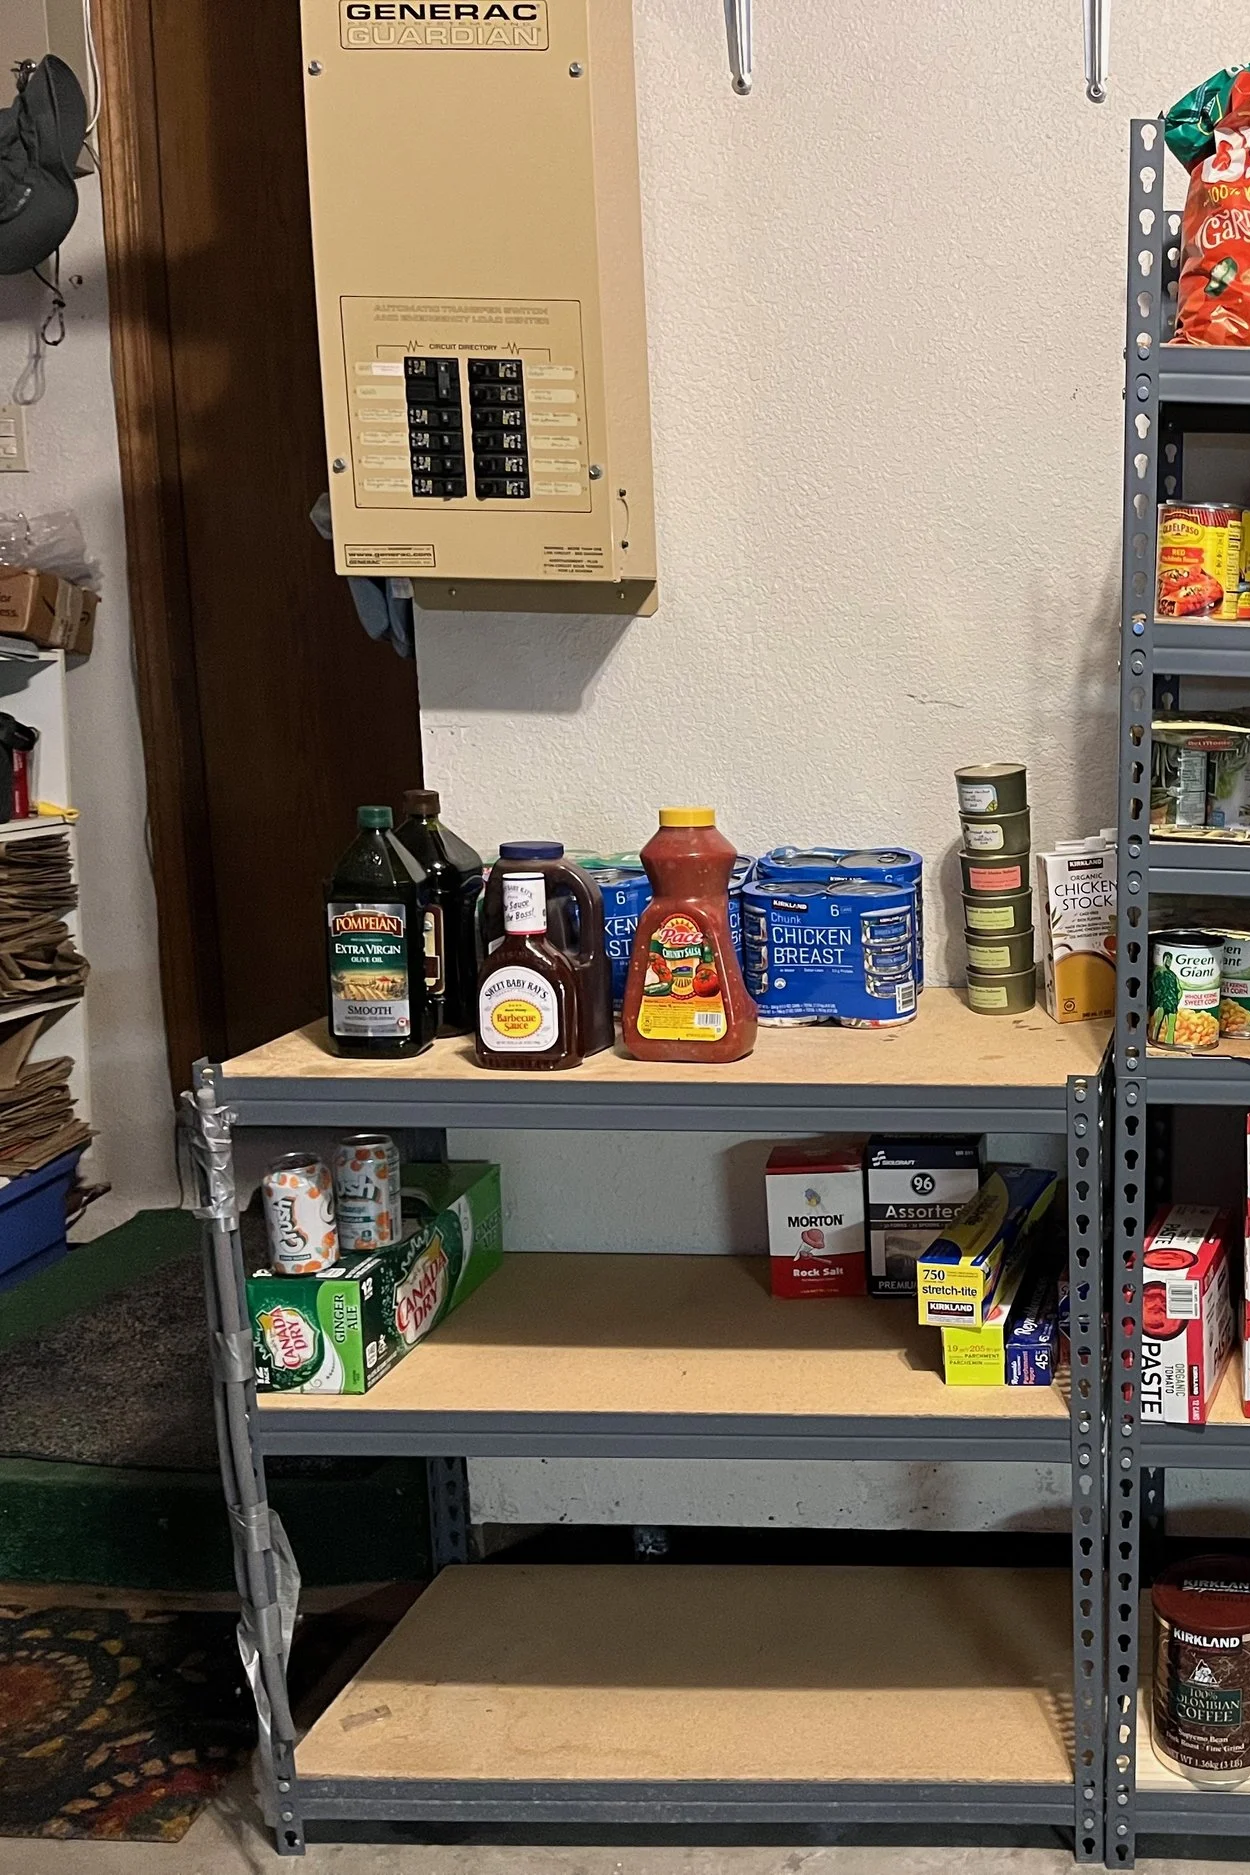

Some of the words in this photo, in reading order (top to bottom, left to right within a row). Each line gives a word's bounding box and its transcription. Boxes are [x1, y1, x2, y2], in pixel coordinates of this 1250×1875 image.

[346, 3, 538, 20] GENERAC
[347, 26, 539, 45] GUARDIAN
[374, 304, 439, 313] AUTOMATIC
[1181, 524, 1199, 536] PASO
[1069, 859, 1102, 867] KIRKLAND
[1070, 872, 1103, 882] ORGANIC
[1054, 880, 1118, 897] CHICKEN
[616, 890, 626, 905] 6
[773, 899, 808, 910] KIRKLAND
[1062, 894, 1114, 911] STOCK
[770, 911, 802, 925] Chunk
[830, 904, 840, 917] 6
[336, 917, 397, 931] POMPEIAN
[660, 928, 704, 945] Pace
[772, 926, 852, 946] CHICKEN
[335, 943, 365, 955] EXTRA
[365, 943, 401, 955] VIRGIN
[662, 947, 684, 958] CHUNKY
[684, 946, 702, 957] SALSA
[773, 948, 845, 965] BREAST
[1175, 953, 1215, 966] Green
[1180, 966, 1214, 978] Giant
[484, 980, 506, 1000] SWEET
[506, 979, 527, 988] BABY
[527, 981, 548, 999] RAY'S
[347, 1005, 392, 1015] SMOOTH
[497, 1013, 537, 1022] Barbecue
[504, 1021, 529, 1032] Sauce
[913, 1176, 933, 1191] 96
[272, 1197, 306, 1254] Crush
[787, 1214, 843, 1229] MORTON
[792, 1267, 820, 1277] Rock
[823, 1266, 844, 1277] Salt
[922, 1269, 945, 1281] 750
[360, 1277, 373, 1294] 12
[397, 1248, 448, 1332] CANADA
[922, 1284, 978, 1297] stretch-tite
[413, 1288, 437, 1331] DRY
[929, 1302, 973, 1312] KIRKLAND
[333, 1294, 345, 1344] GINGER
[346, 1305, 358, 1331] ALE
[270, 1307, 301, 1369] CANADA
[287, 1320, 308, 1351] DRY
[1035, 1354, 1049, 1370] 45
[1141, 1342, 1163, 1415] PASTE
[1164, 1365, 1174, 1394] TOMATO
[1175, 1363, 1186, 1397] ORGANIC
[1173, 1627, 1241, 1649] KIRKLAND
[1189, 1686, 1218, 1700] 100%
[1176, 1704, 1233, 1723] COFFEE
[1178, 1728, 1208, 1743] Supremo
[1181, 1740, 1200, 1751] Roast
[1206, 1744, 1222, 1752] Fine
[1223, 1743, 1245, 1752] Grind
[1180, 1753, 1193, 1765] WT
[1194, 1758, 1220, 1771] 1.36kg
